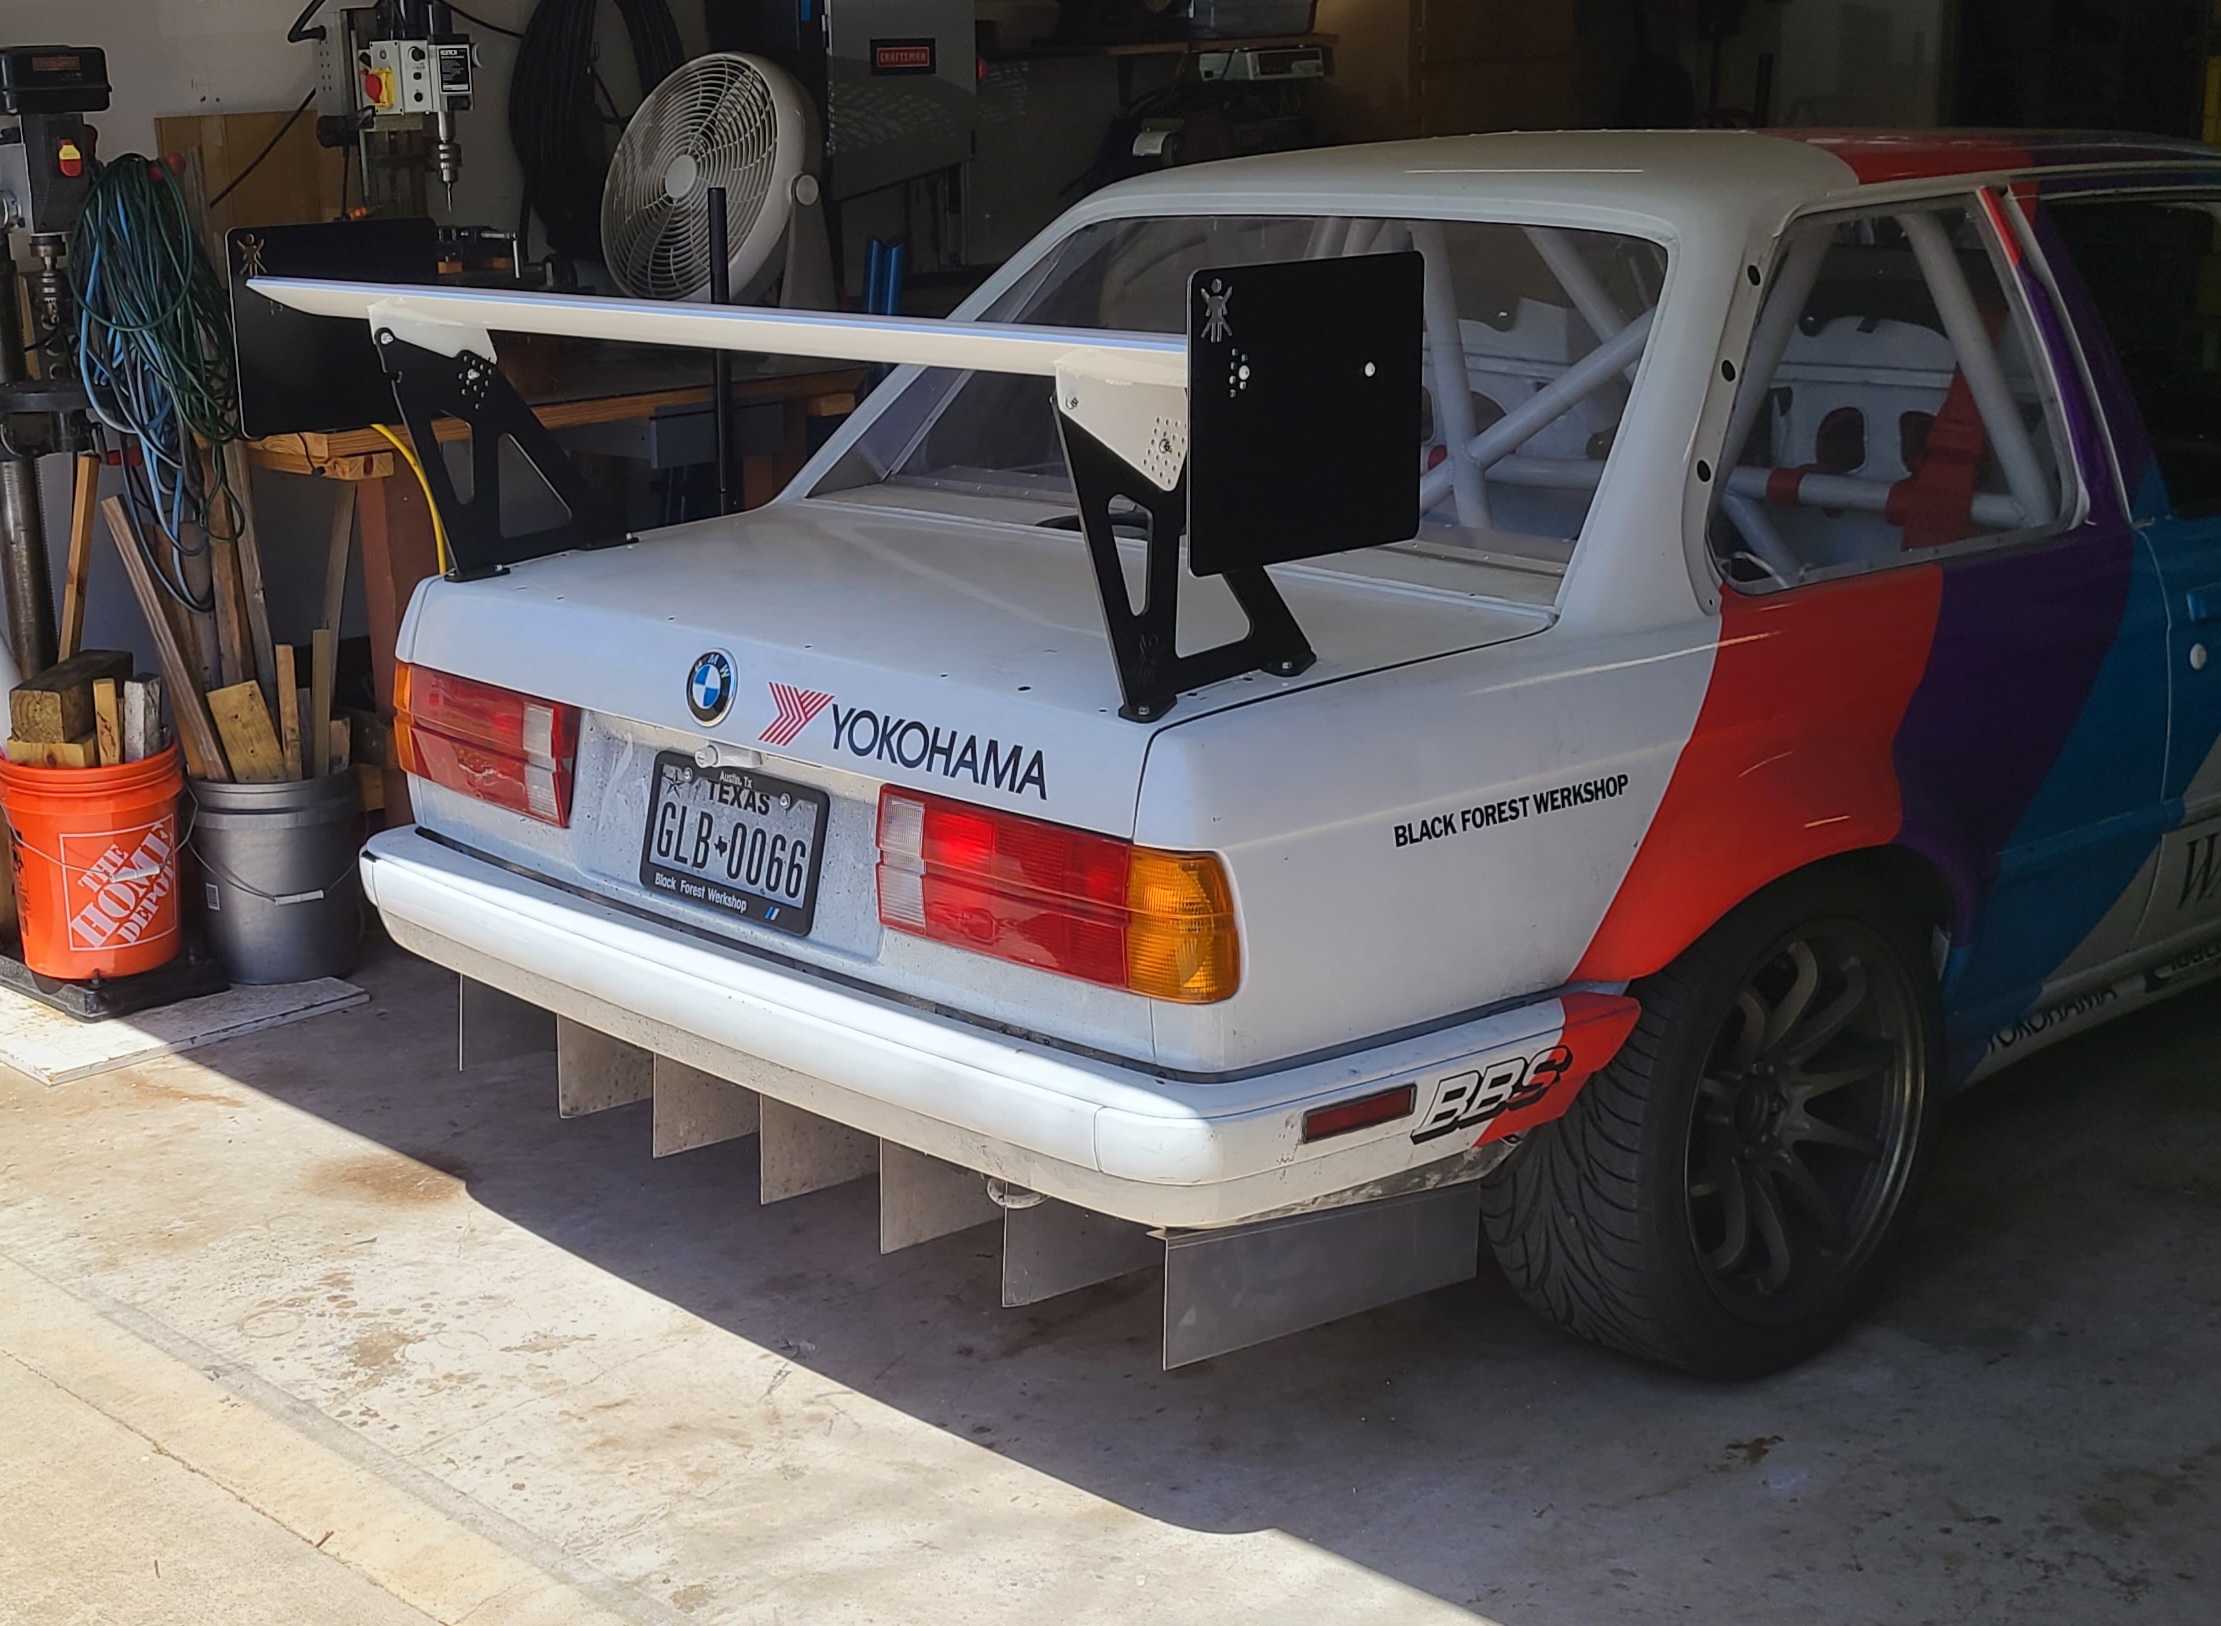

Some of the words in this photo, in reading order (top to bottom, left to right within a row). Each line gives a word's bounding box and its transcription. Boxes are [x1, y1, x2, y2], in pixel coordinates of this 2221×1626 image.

[880, 51, 927, 63] CRAFTSMAN
[831, 702, 1048, 801] YOKOHAMA
[708, 779, 771, 816] TEXAS
[1394, 813, 1458, 848] BLACK
[1460, 796, 1531, 832] FOREST
[1533, 774, 1630, 816] WERKSHOP
[71, 822, 173, 948] HOME
[77, 843, 130, 893] THE
[117, 861, 174, 943] DEPOT
[680, 879, 706, 899] Forest
[707, 886, 747, 914] Werkshop
[1409, 1045, 1574, 1146] BBS
